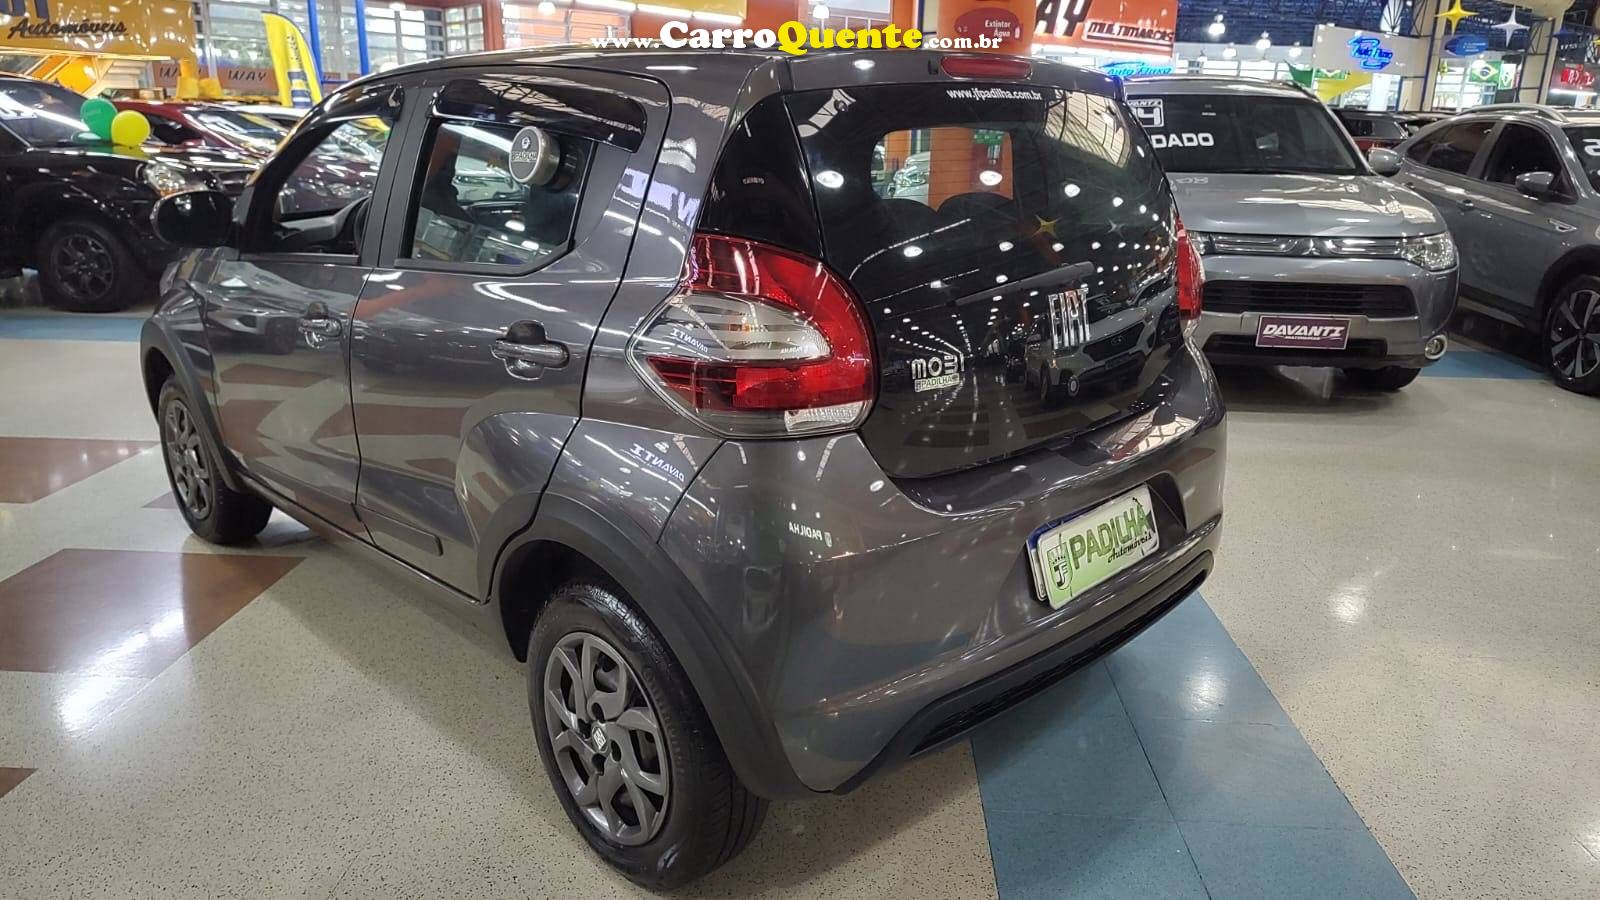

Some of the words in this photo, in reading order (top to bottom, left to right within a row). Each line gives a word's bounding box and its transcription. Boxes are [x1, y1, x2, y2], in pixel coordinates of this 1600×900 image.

[984, 20, 1012, 28] Extintor
[1048, 287, 1091, 350] FIAT
[1262, 324, 1345, 337] DAVANTI
[1068, 505, 1149, 570] PADILHA
